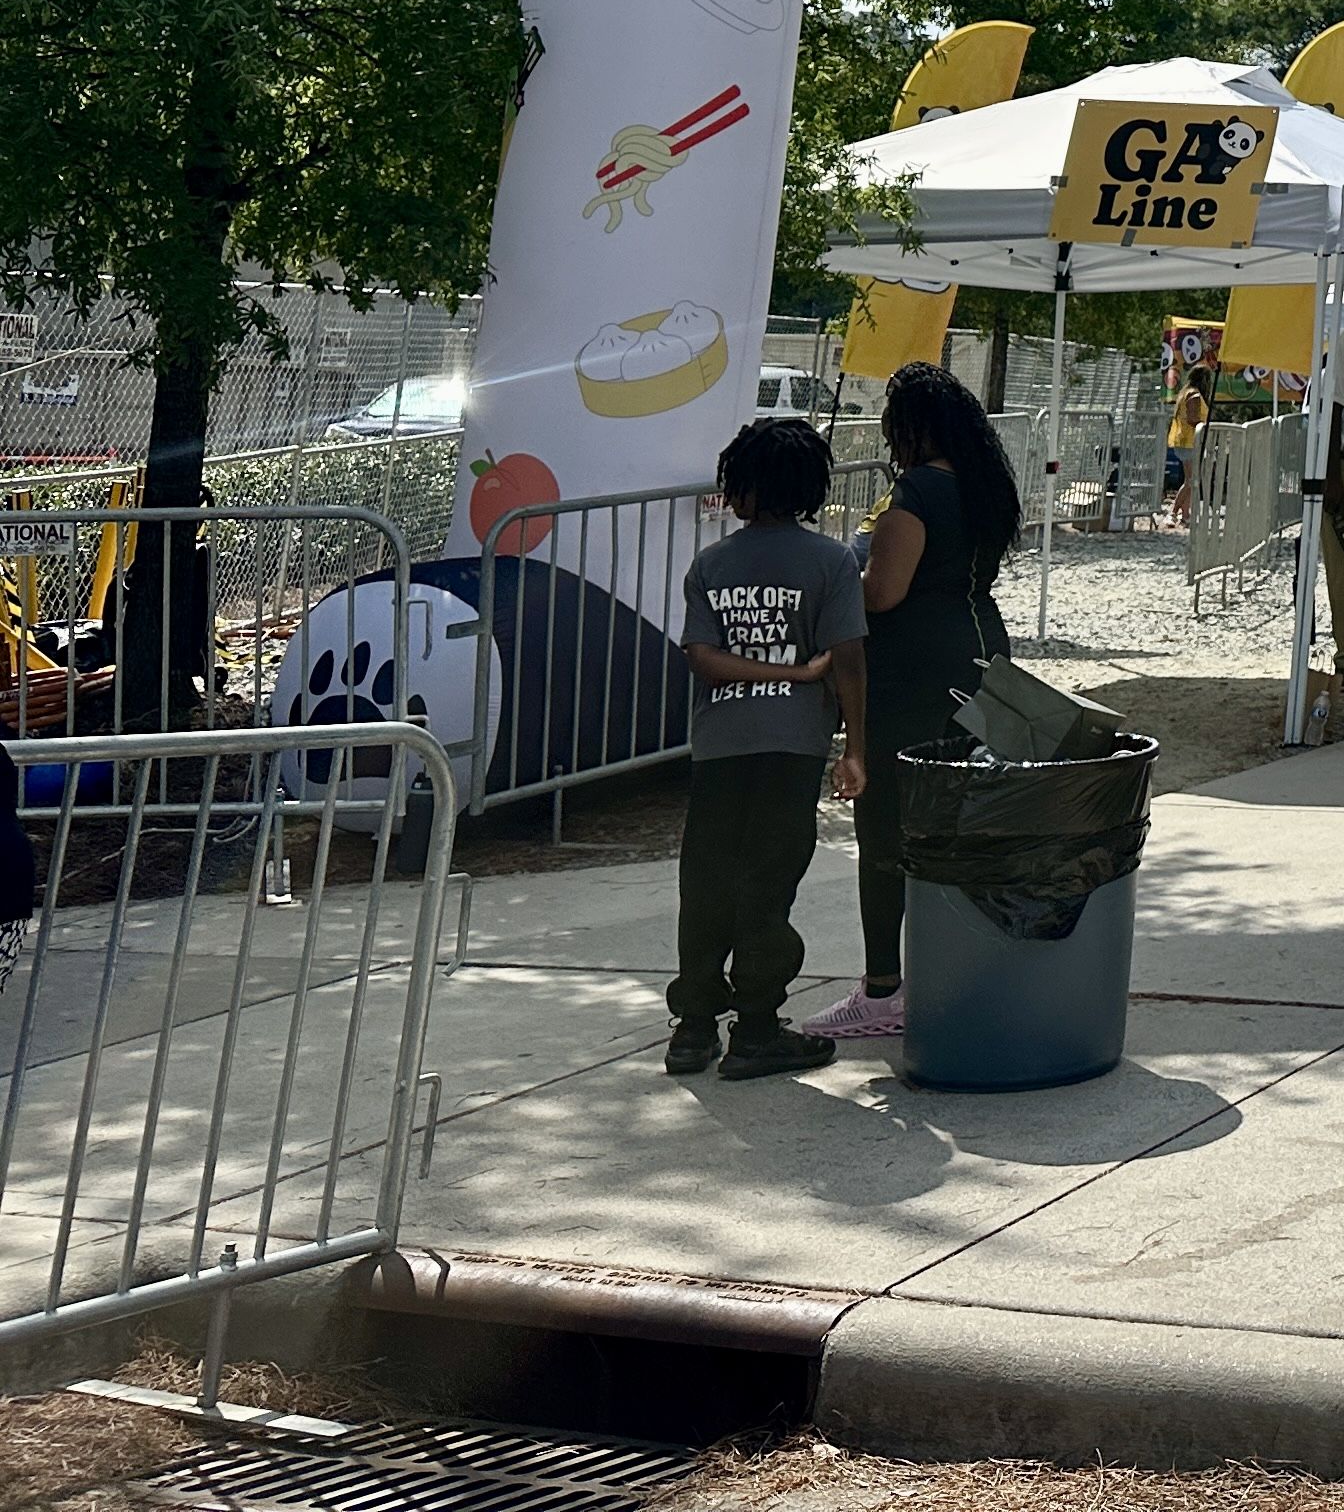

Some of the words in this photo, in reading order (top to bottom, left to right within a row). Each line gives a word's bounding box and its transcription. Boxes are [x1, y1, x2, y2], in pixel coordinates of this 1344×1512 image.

[1104, 118, 1227, 185] GA
[1092, 183, 1218, 231] Line
[722, 612, 728, 626] I
[730, 609, 770, 624] HAVE
[775, 609, 786, 623] A
[727, 623, 789, 646] CRAZY
[711, 681, 745, 703] USE
[751, 680, 792, 697] HER
